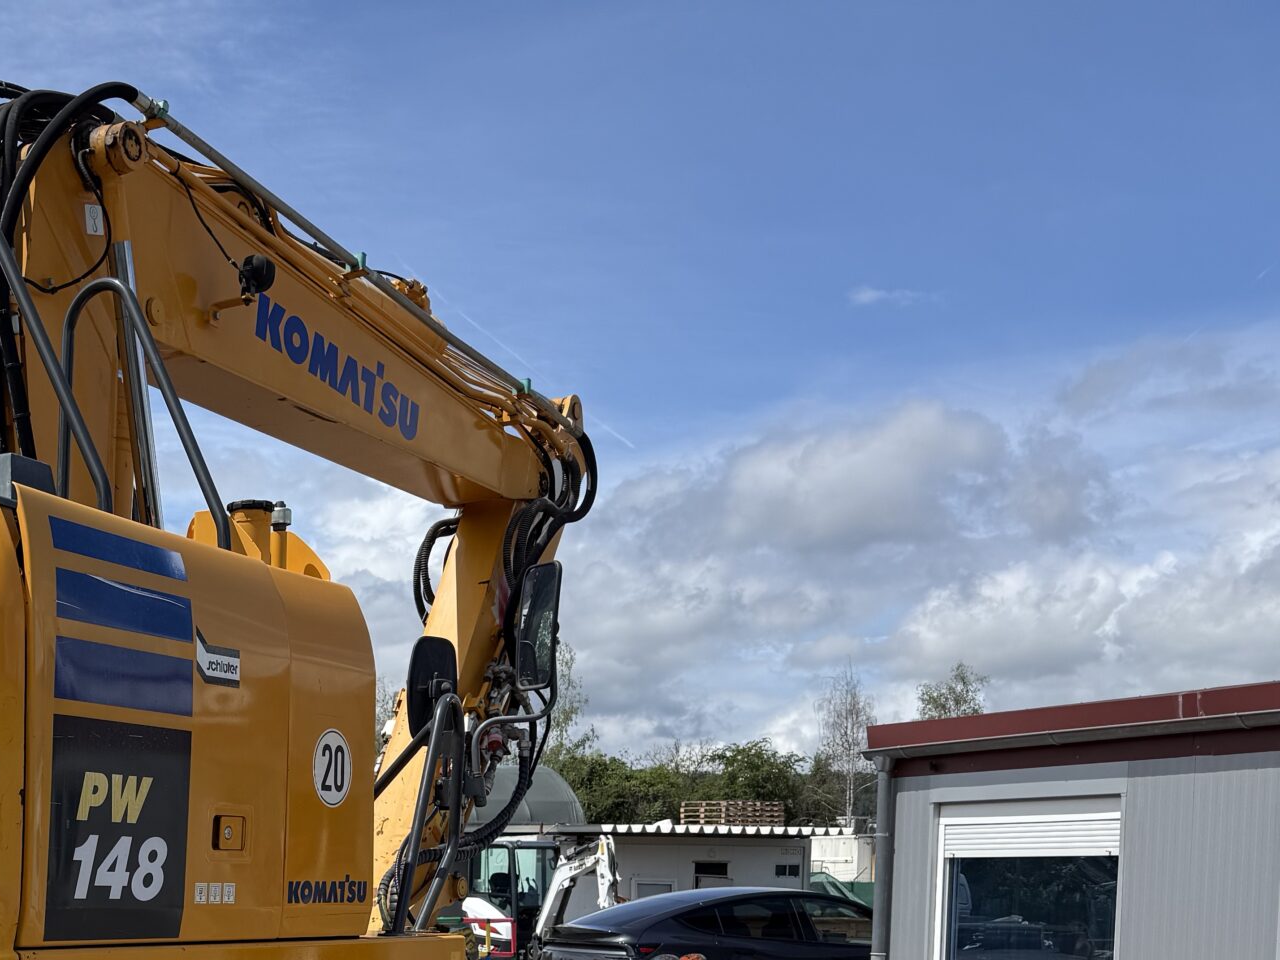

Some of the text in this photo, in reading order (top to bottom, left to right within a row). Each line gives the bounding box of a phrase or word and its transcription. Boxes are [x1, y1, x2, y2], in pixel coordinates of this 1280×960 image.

[255, 292, 419, 441] KOMATSU
[321, 743, 345, 793] 20
[76, 771, 154, 824] PW
[72, 834, 168, 902] 148
[287, 874, 368, 904] KOMATSU
